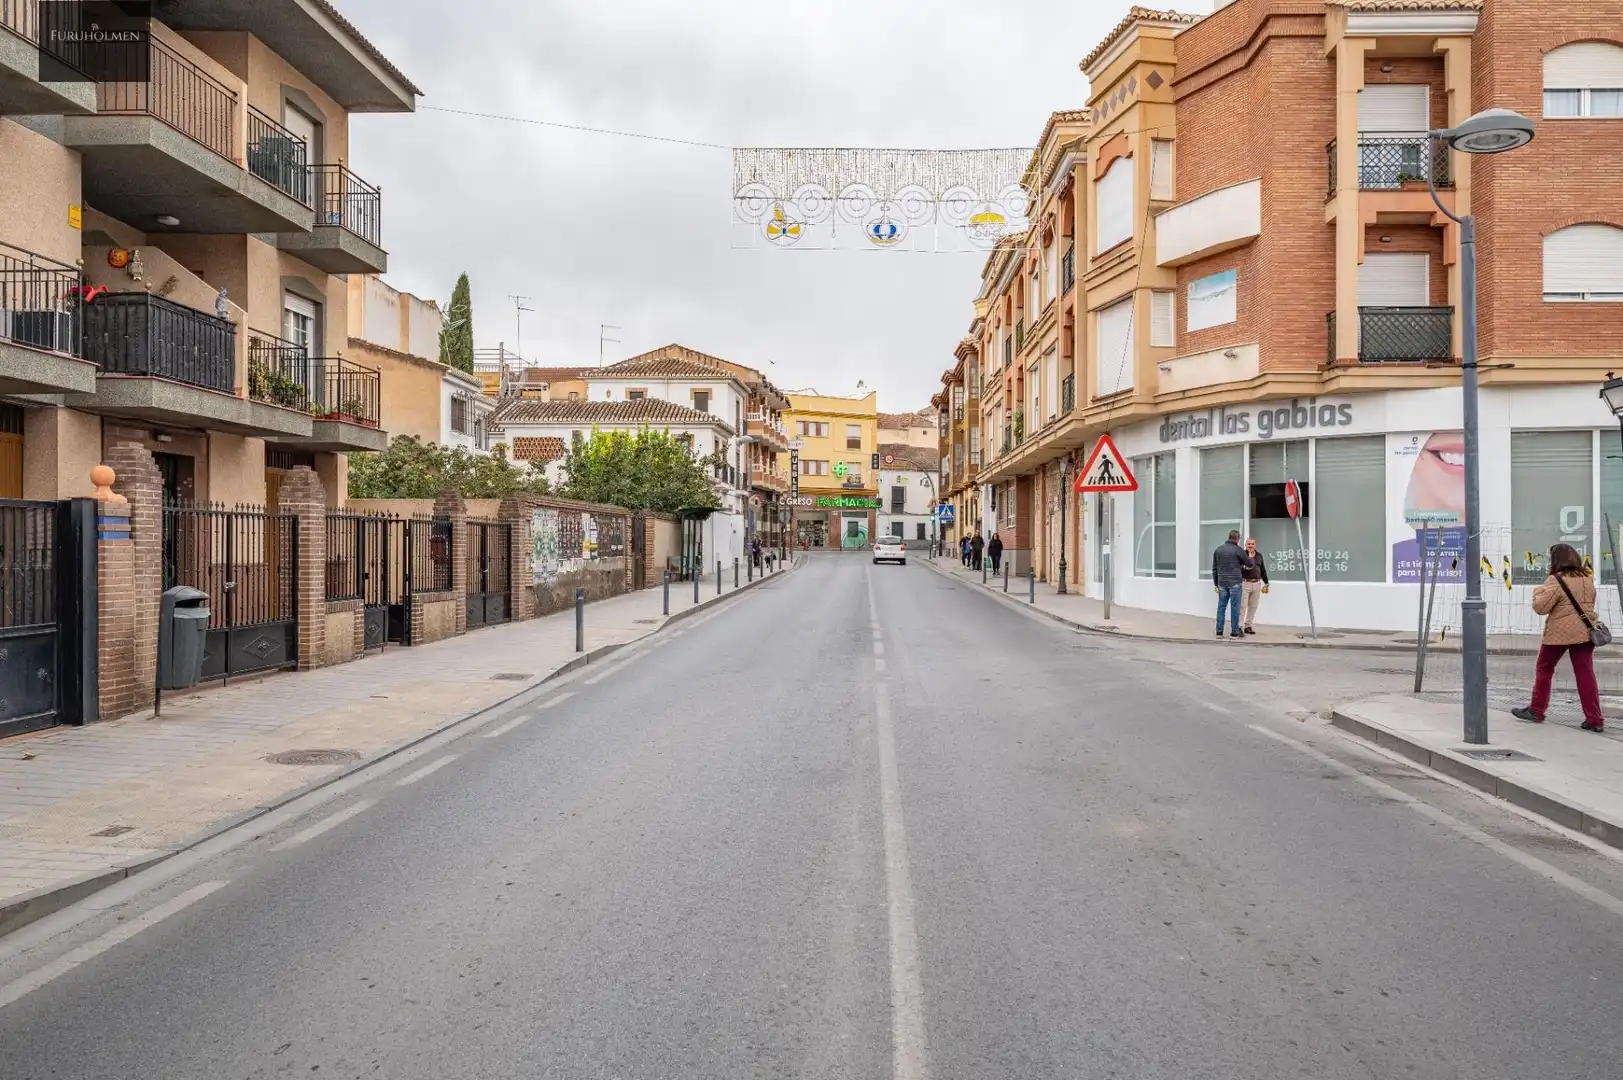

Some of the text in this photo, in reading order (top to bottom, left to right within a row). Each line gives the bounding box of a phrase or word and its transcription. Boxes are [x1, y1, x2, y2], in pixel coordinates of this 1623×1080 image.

[1159, 398, 1353, 443] dental las gabias
[818, 498, 878, 508] FARMACIA
[1276, 548, 1295, 561] 958
[1317, 548, 1332, 560] 80
[1334, 550, 1349, 561] 24
[1277, 560, 1296, 571] 626
[1315, 560, 1331, 573] 48
[1335, 560, 1348, 572] 16
[1427, 568, 1462, 577] snrisa!
